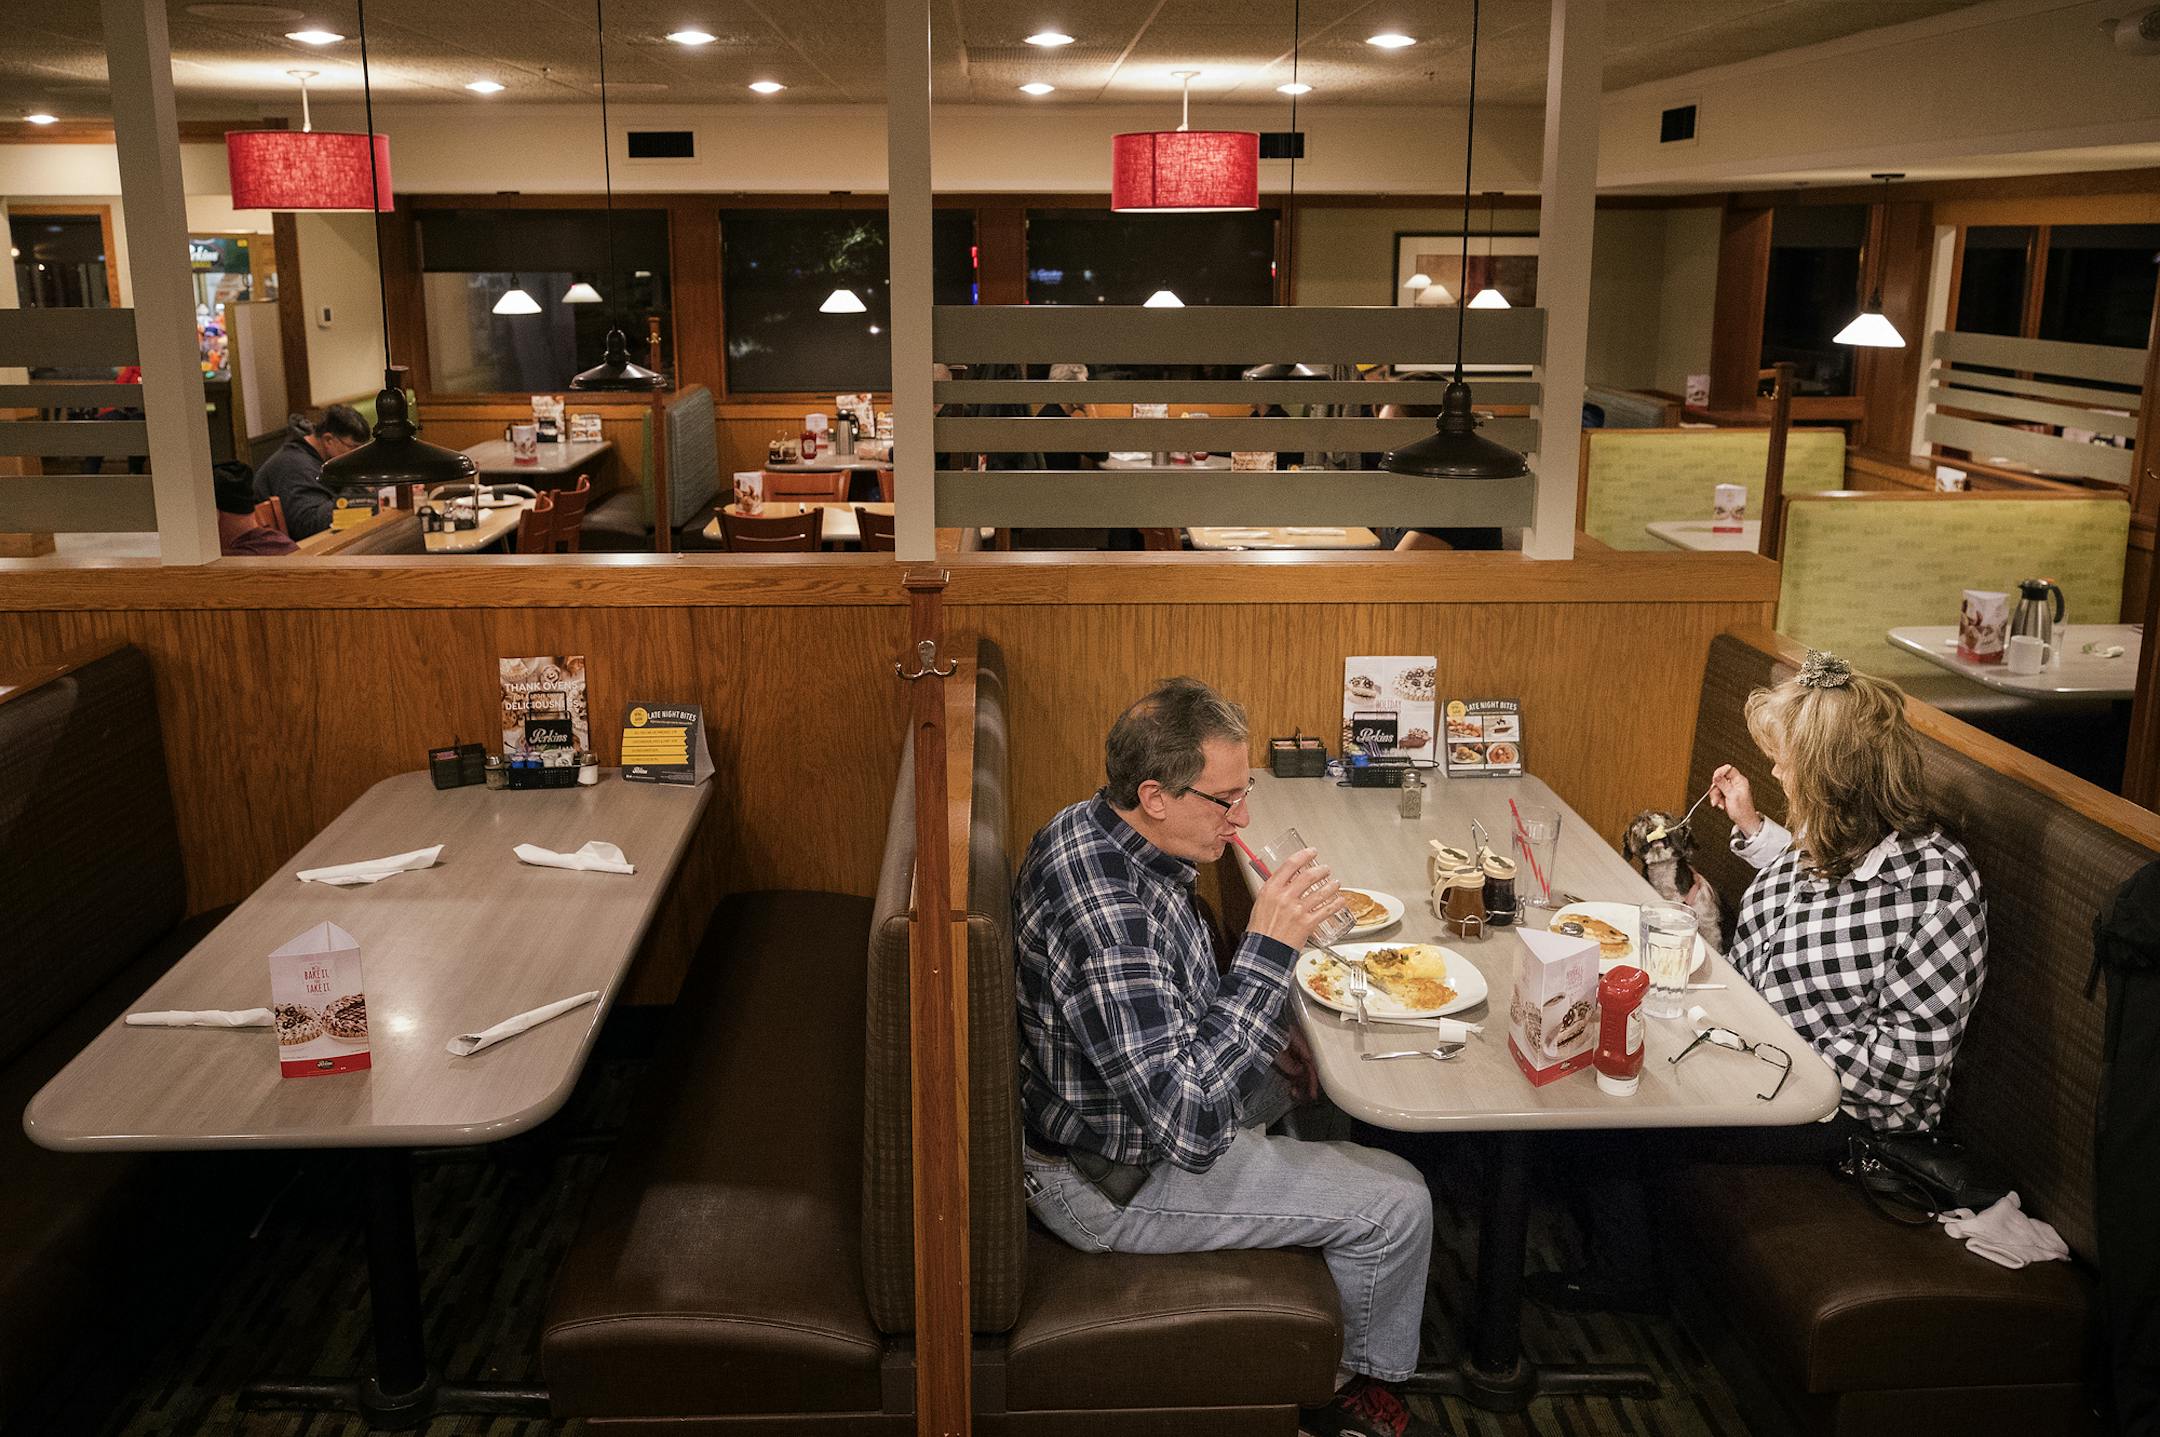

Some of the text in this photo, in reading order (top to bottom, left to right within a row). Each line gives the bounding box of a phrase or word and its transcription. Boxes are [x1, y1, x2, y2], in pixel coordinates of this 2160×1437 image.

[504, 681, 578, 692] THANK OVENS
[1465, 702, 1480, 712] LATE
[1480, 700, 1499, 709] NIGHT
[1500, 701, 1517, 711] BITES
[647, 711, 661, 720] LATE
[662, 710, 680, 718] NIGHT
[680, 711, 697, 722] BITES
[528, 727, 568, 744] Perkins
